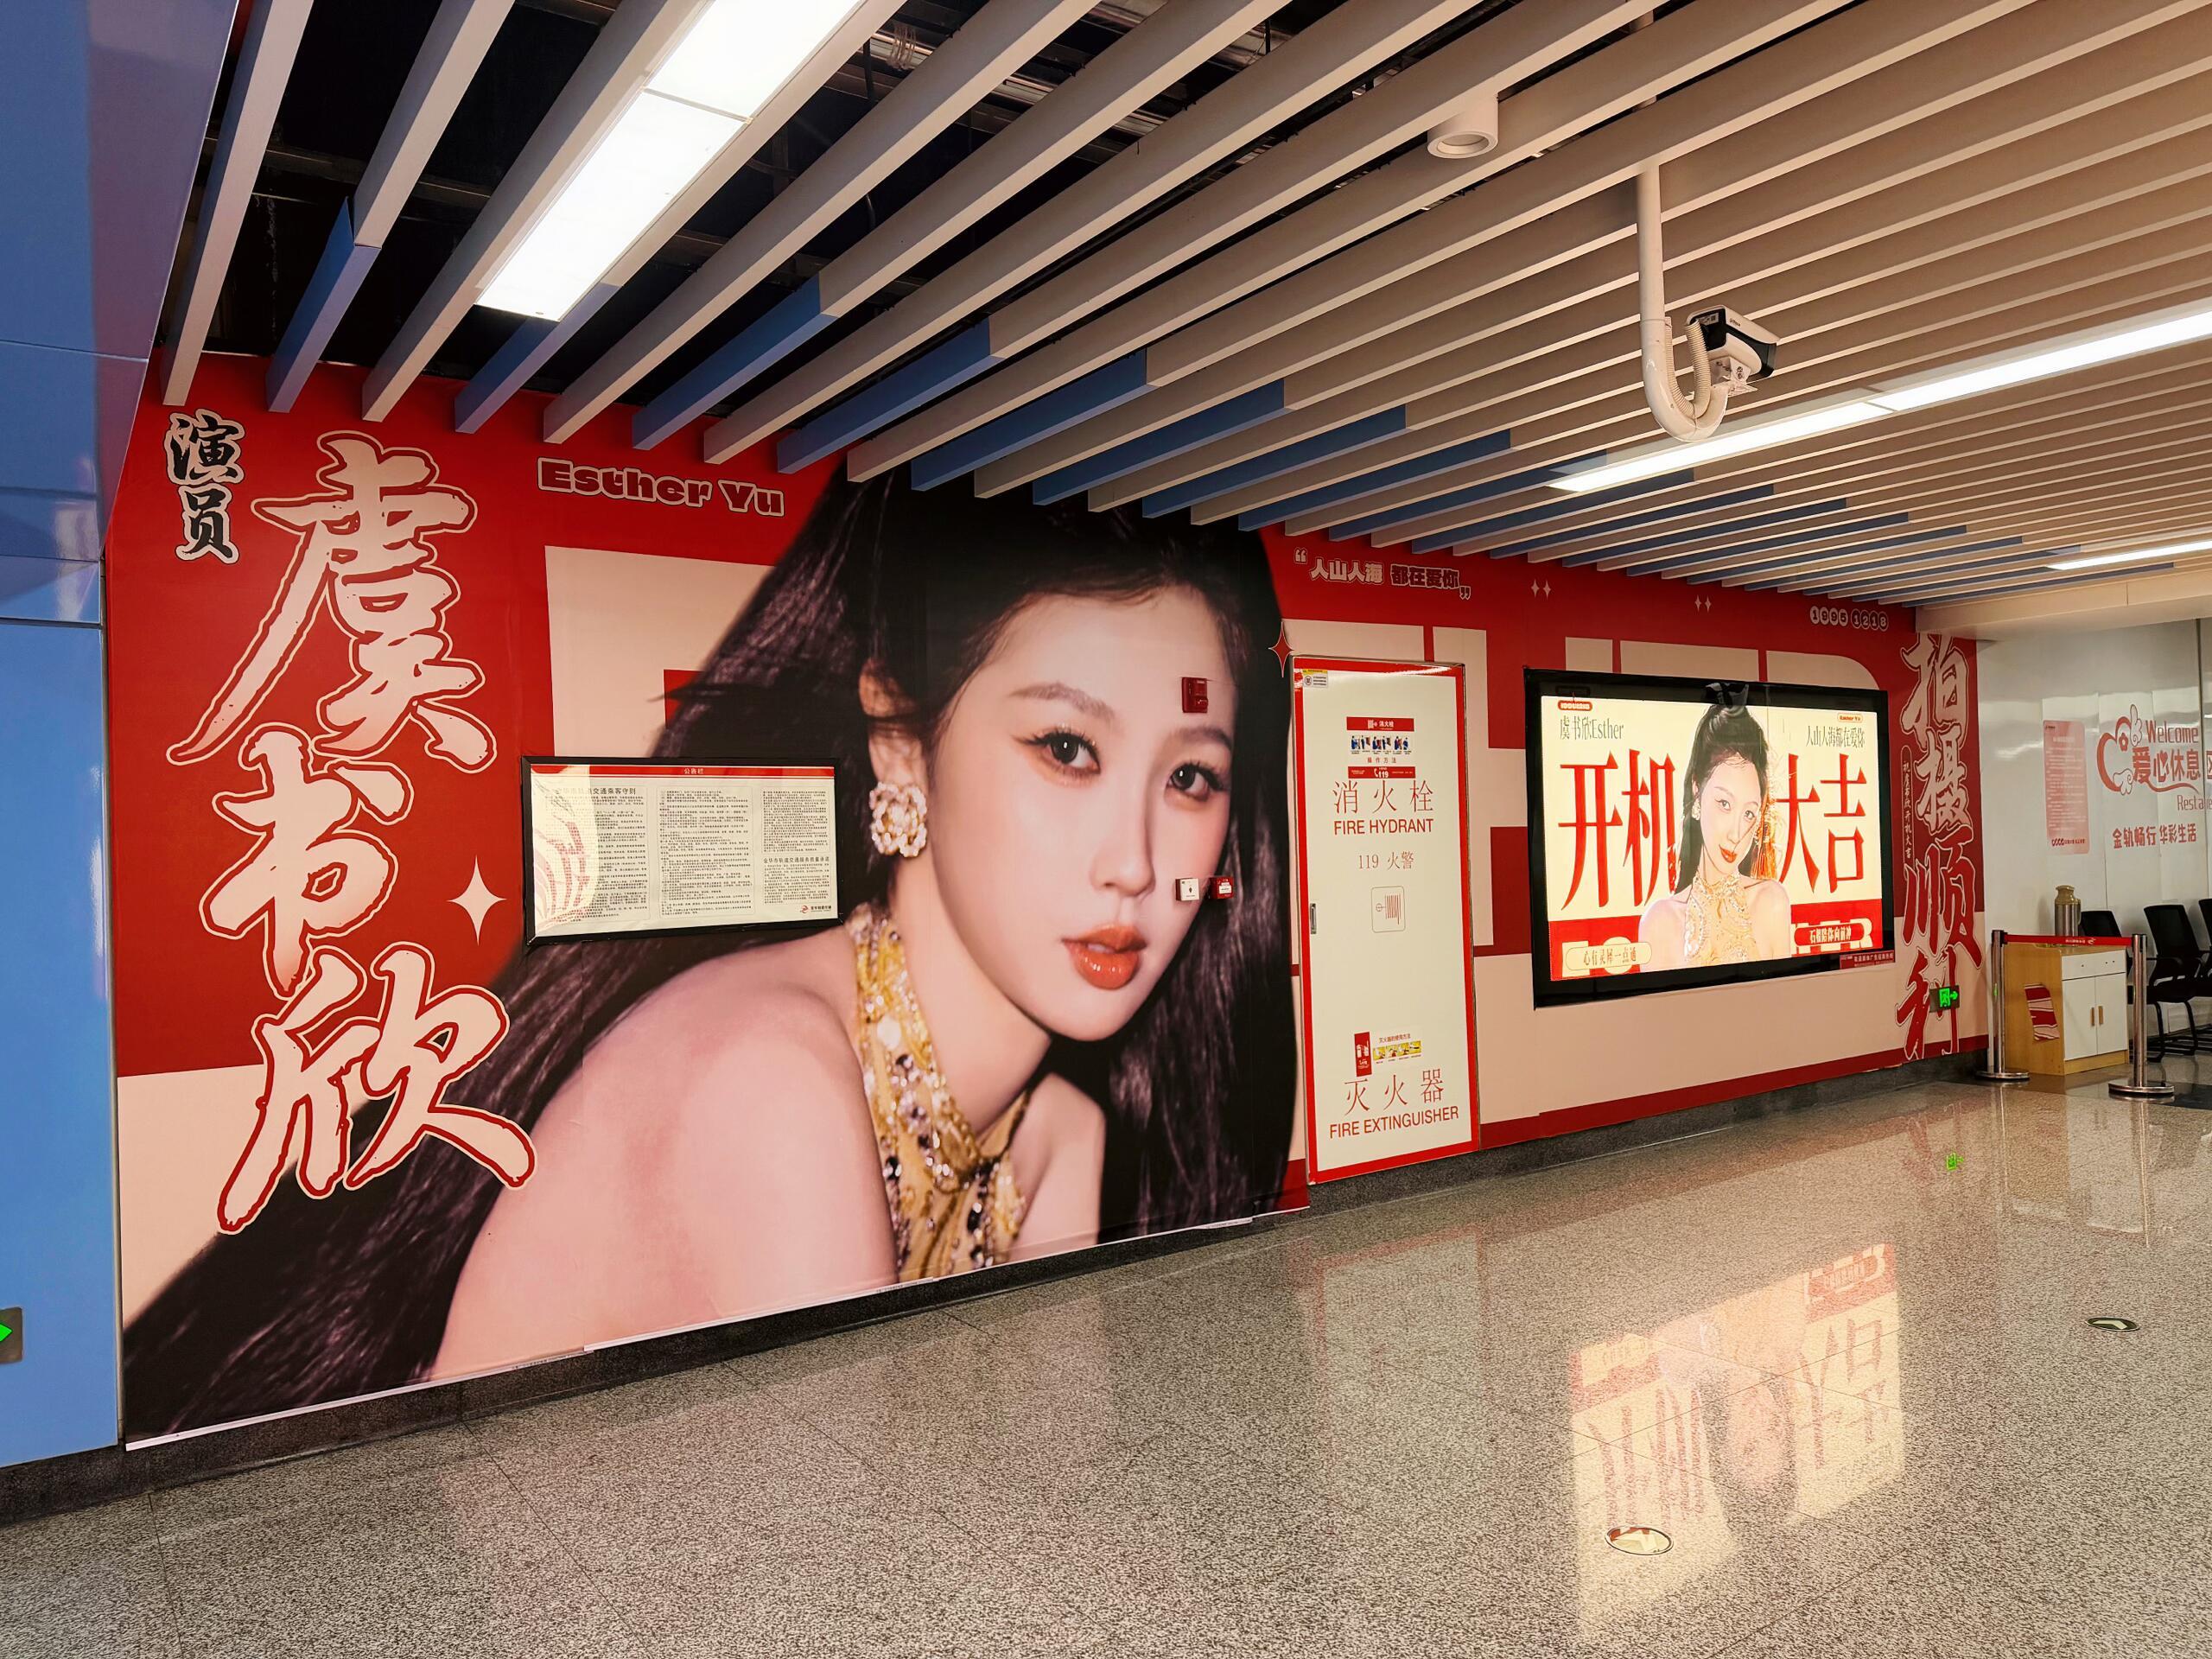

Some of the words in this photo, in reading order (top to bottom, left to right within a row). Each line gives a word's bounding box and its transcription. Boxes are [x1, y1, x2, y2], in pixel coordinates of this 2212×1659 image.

[166, 410, 245, 564] 演员
[537, 457, 713, 507] Esther
[717, 480, 784, 516] Yu
[1811, 607, 1847, 625] 1995
[1852, 610, 1887, 630] 1218
[2145, 720, 2199, 743] Welcome
[1332, 779, 1433, 814] 消火栓
[167, 430, 536, 1236] 虞书欣
[1334, 820, 1365, 835] FIRE
[1370, 818, 1433, 834] HYDRANT
[1558, 749, 1676, 911] 开机
[1777, 753, 1867, 894] 大吉
[2112, 826, 2157, 849] 金轨畅行
[2159, 823, 2196, 844] 华彩生活
[1359, 854, 1379, 869] 119
[1387, 851, 1414, 870] 火警
[1897, 632, 1982, 1059] 拍摄顺利
[1344, 1068, 1444, 1116] 灭火器
[1330, 1121, 1360, 1139] FIRE
[1364, 1106, 1459, 1134] EXTINGUISHER
